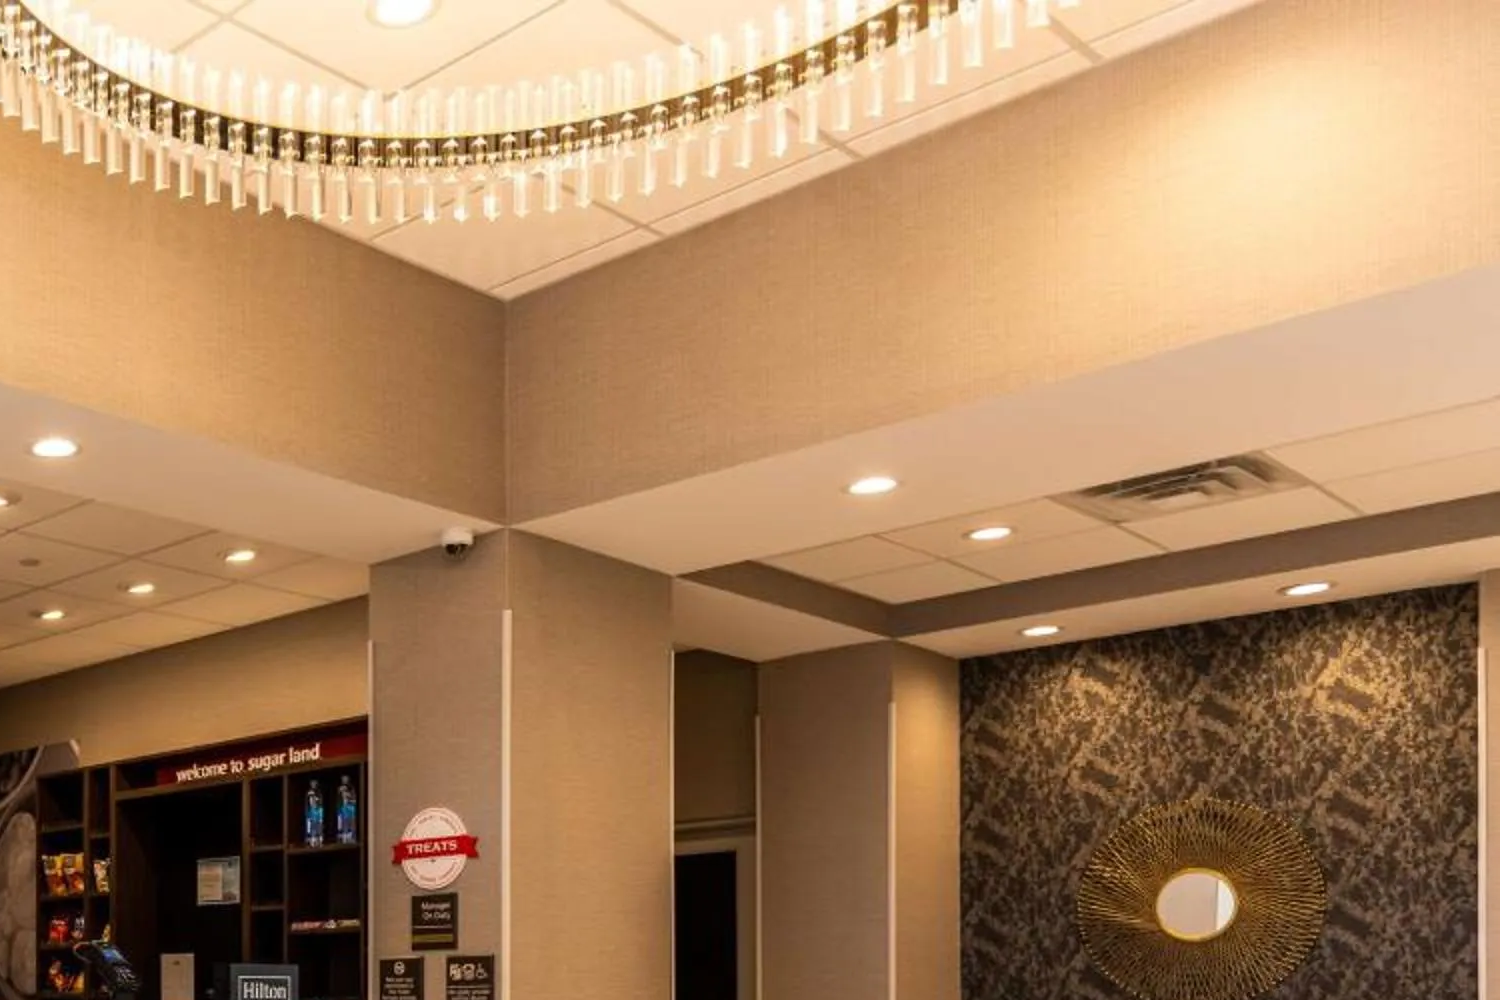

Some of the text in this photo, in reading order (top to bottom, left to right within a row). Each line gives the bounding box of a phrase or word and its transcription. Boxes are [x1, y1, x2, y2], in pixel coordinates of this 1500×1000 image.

[176, 743, 321, 783] welcome to sugar land
[406, 840, 458, 855] TREATS
[243, 981, 287, 999] Hilton
